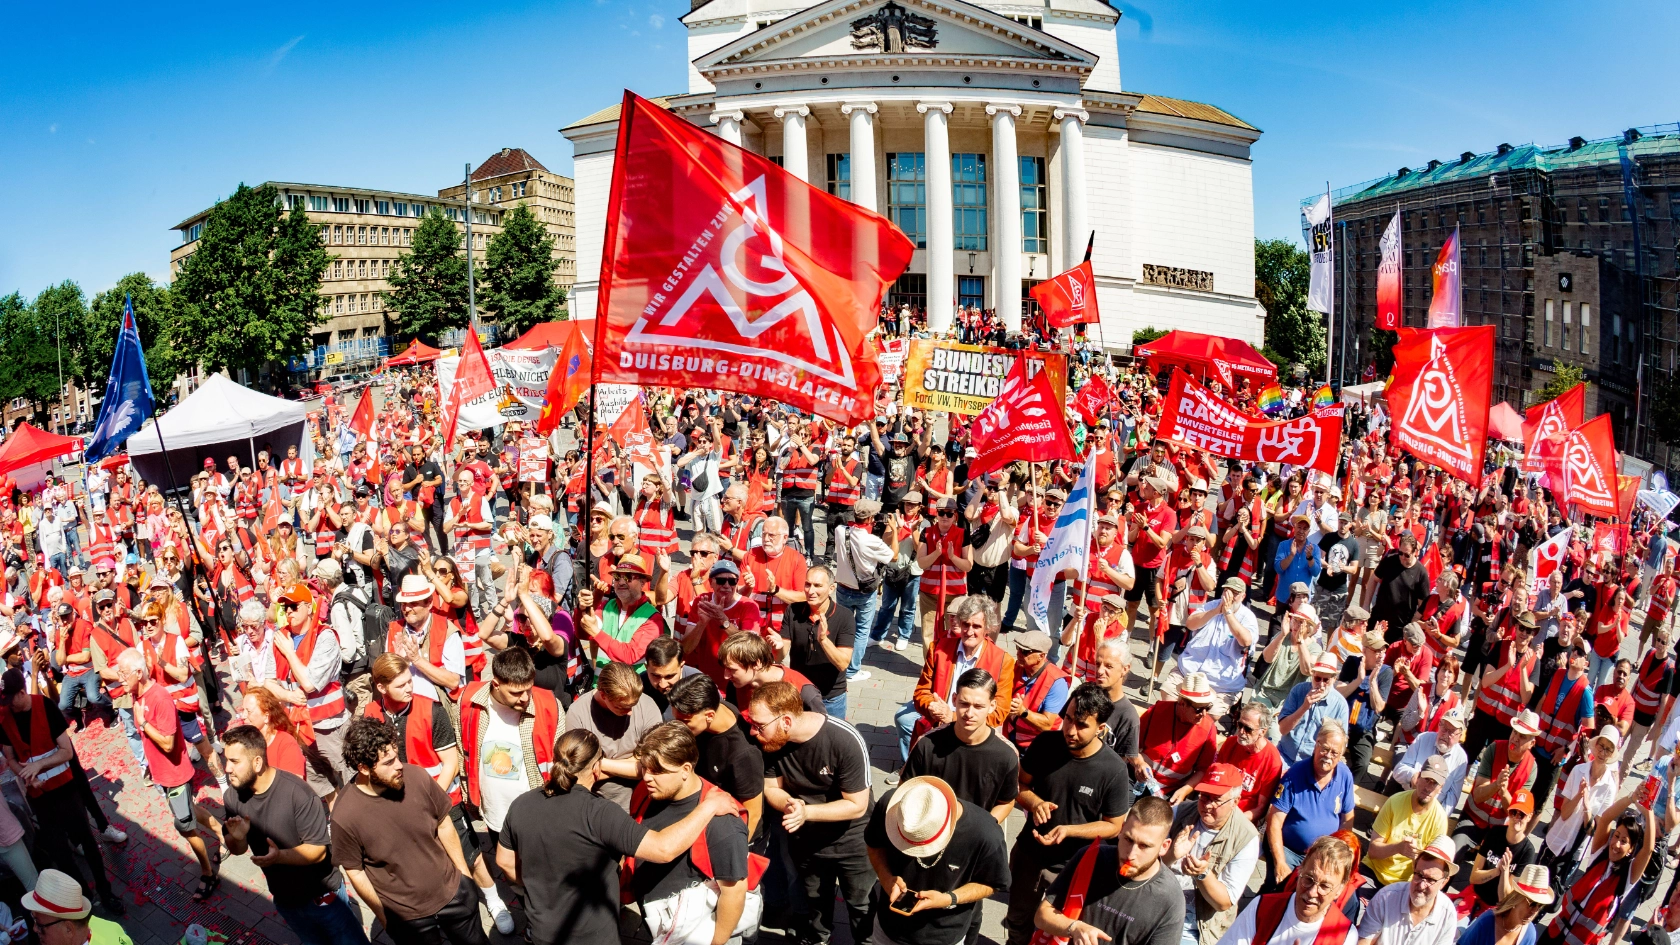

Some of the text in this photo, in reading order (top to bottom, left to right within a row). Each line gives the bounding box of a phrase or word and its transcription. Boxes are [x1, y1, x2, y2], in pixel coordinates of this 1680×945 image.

[643, 292, 667, 316] WIR
[663, 228, 714, 293] GESTALTEN
[519, 371, 549, 382] NICHT
[619, 351, 857, 412] DUISBURG-DINSLAKEN
[1237, 364, 1255, 373] METALL
[915, 391, 934, 406] Ford,
[937, 394, 951, 408] VW,
[1171, 425, 1242, 457] JETZT!
[1176, 415, 1244, 442] UMVERTEILEN
